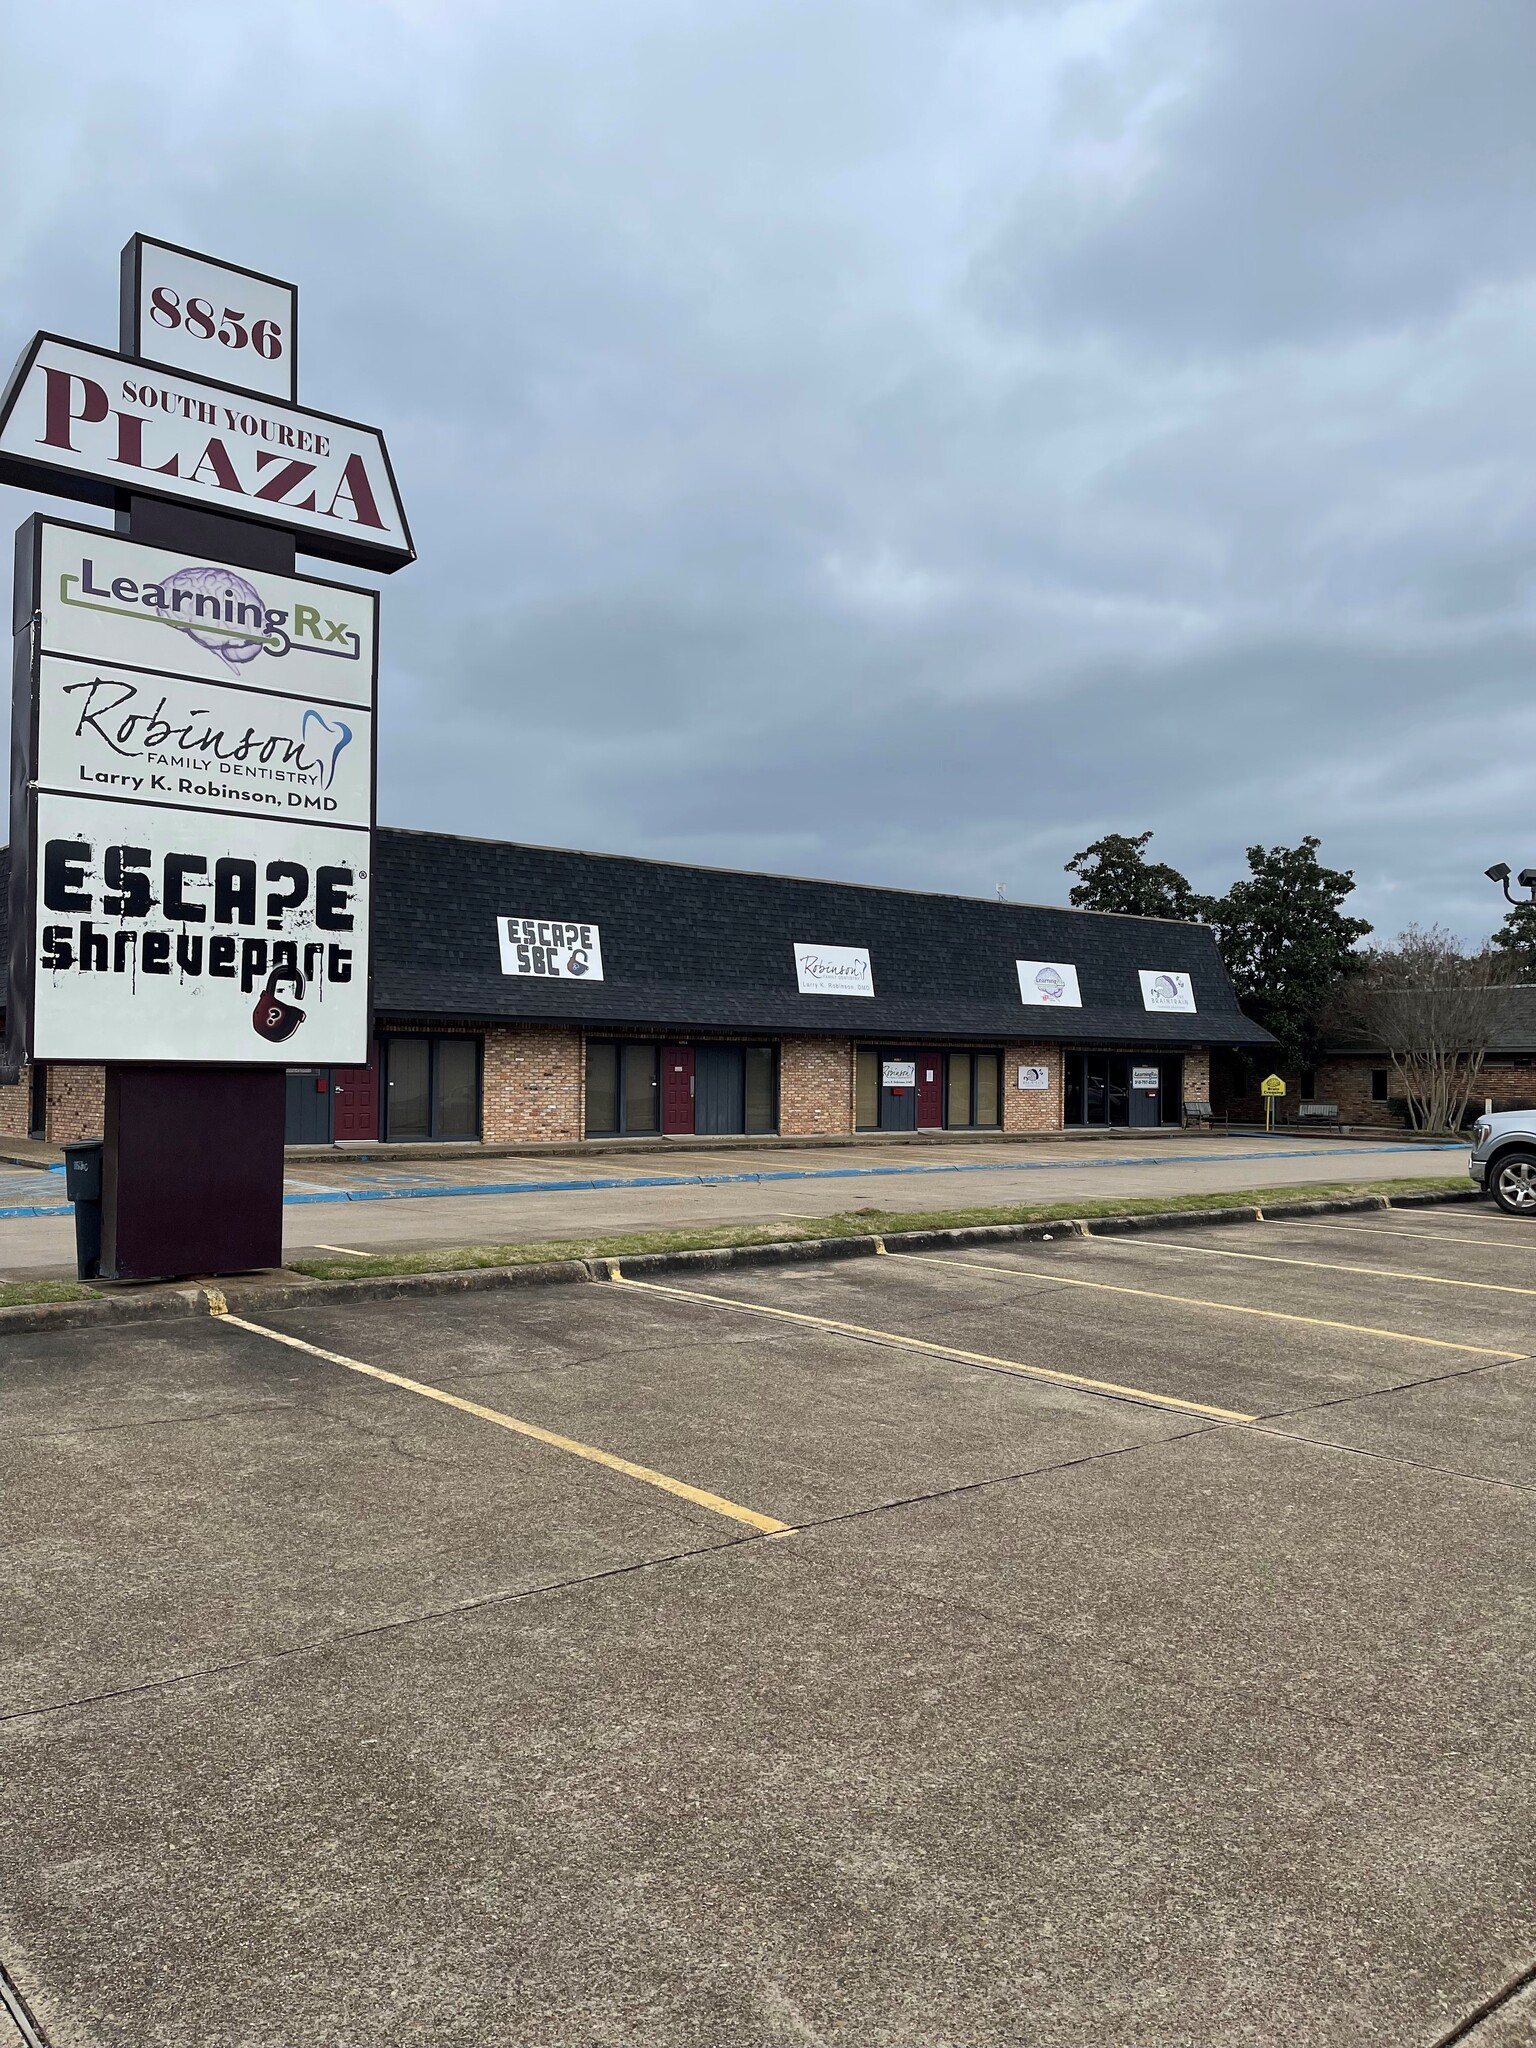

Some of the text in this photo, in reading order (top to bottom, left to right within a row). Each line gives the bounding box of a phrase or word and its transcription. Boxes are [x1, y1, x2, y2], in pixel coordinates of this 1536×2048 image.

[149, 286, 284, 360] 8856
[121, 379, 331, 458] SOUTH YOUREE
[35, 364, 391, 532] PLAZA
[63, 676, 320, 771] Robinson
[79, 765, 338, 812] Larry K. Robinson, DMD
[147, 752, 319, 786] FAMILY DENTISTRY
[517, 944, 560, 976] SBC
[800, 955, 862, 979] Robinson
[802, 981, 818, 989] Larry
